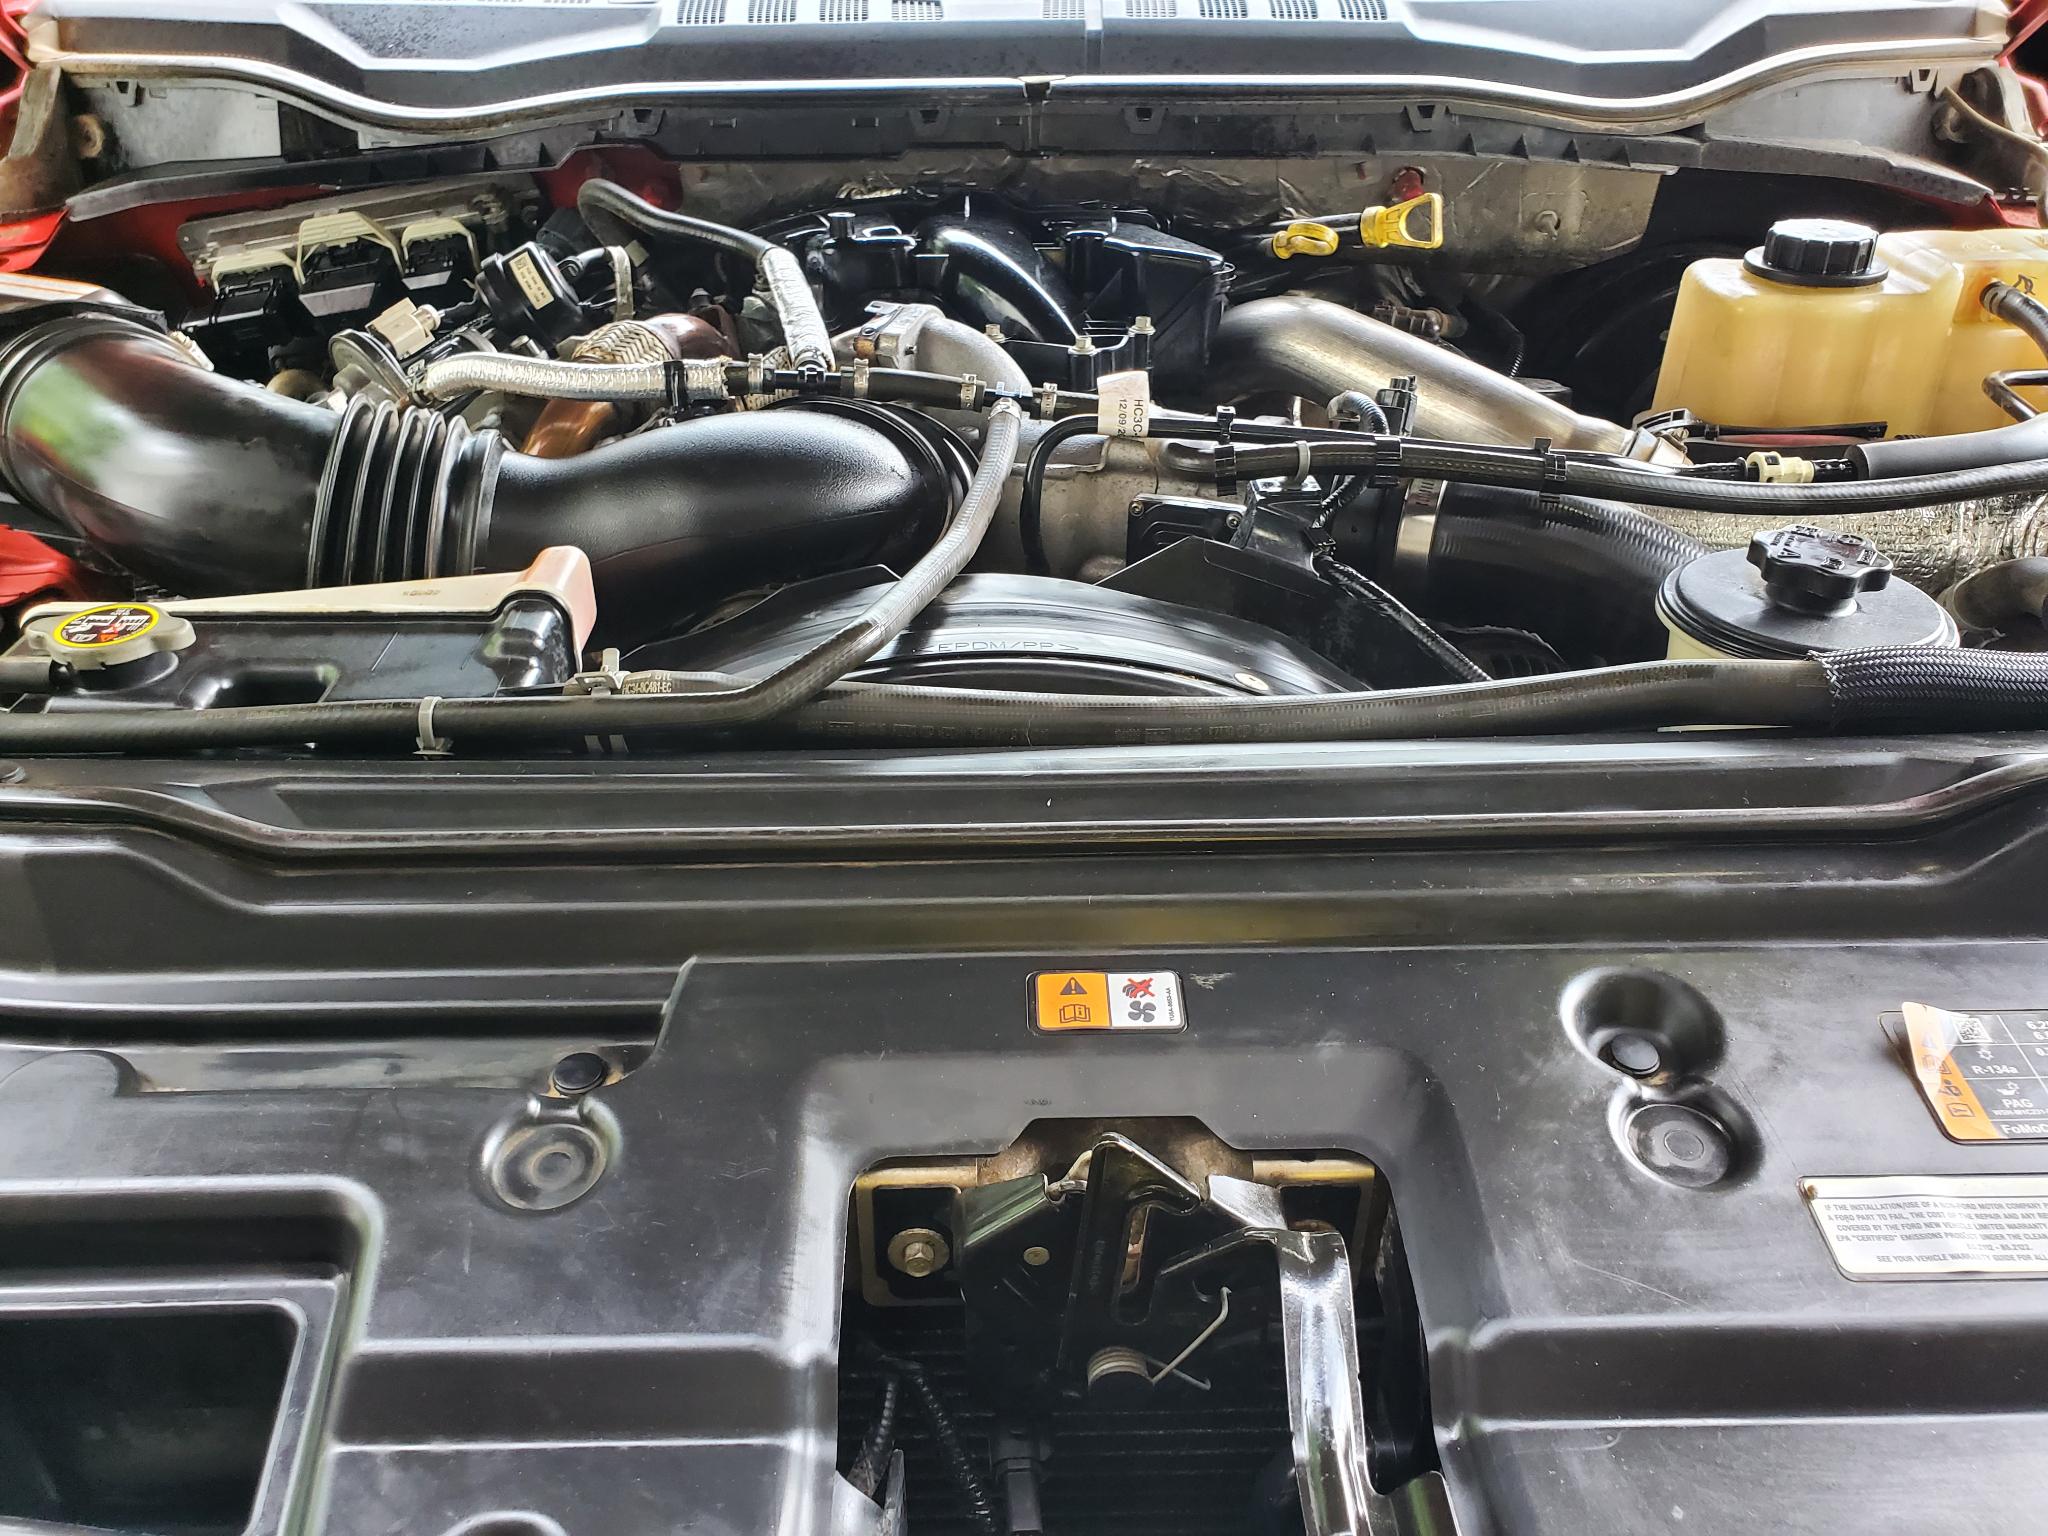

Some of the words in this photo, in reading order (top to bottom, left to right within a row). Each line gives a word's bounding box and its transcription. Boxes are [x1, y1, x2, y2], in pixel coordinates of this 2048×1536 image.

[1971, 1064, 2020, 1075] R-134a
[2001, 1098, 2035, 1109] PAG
[1834, 1214, 1855, 1222] FORD
[1927, 1211, 1945, 1219] COST
[1837, 1224, 1871, 1232] COVERED
[1901, 1222, 1922, 1231] FORD
[1923, 1221, 1941, 1230] NEW
[1974, 1223, 2005, 1231] LIMITED
[1900, 1232, 1943, 1242] EMISSIONS
[1980, 1233, 2005, 1241] UNDER
[2006, 1233, 2022, 1241] THE
[1876, 1255, 1893, 1263] SEE
[1915, 1253, 1948, 1262] VEHICLE
